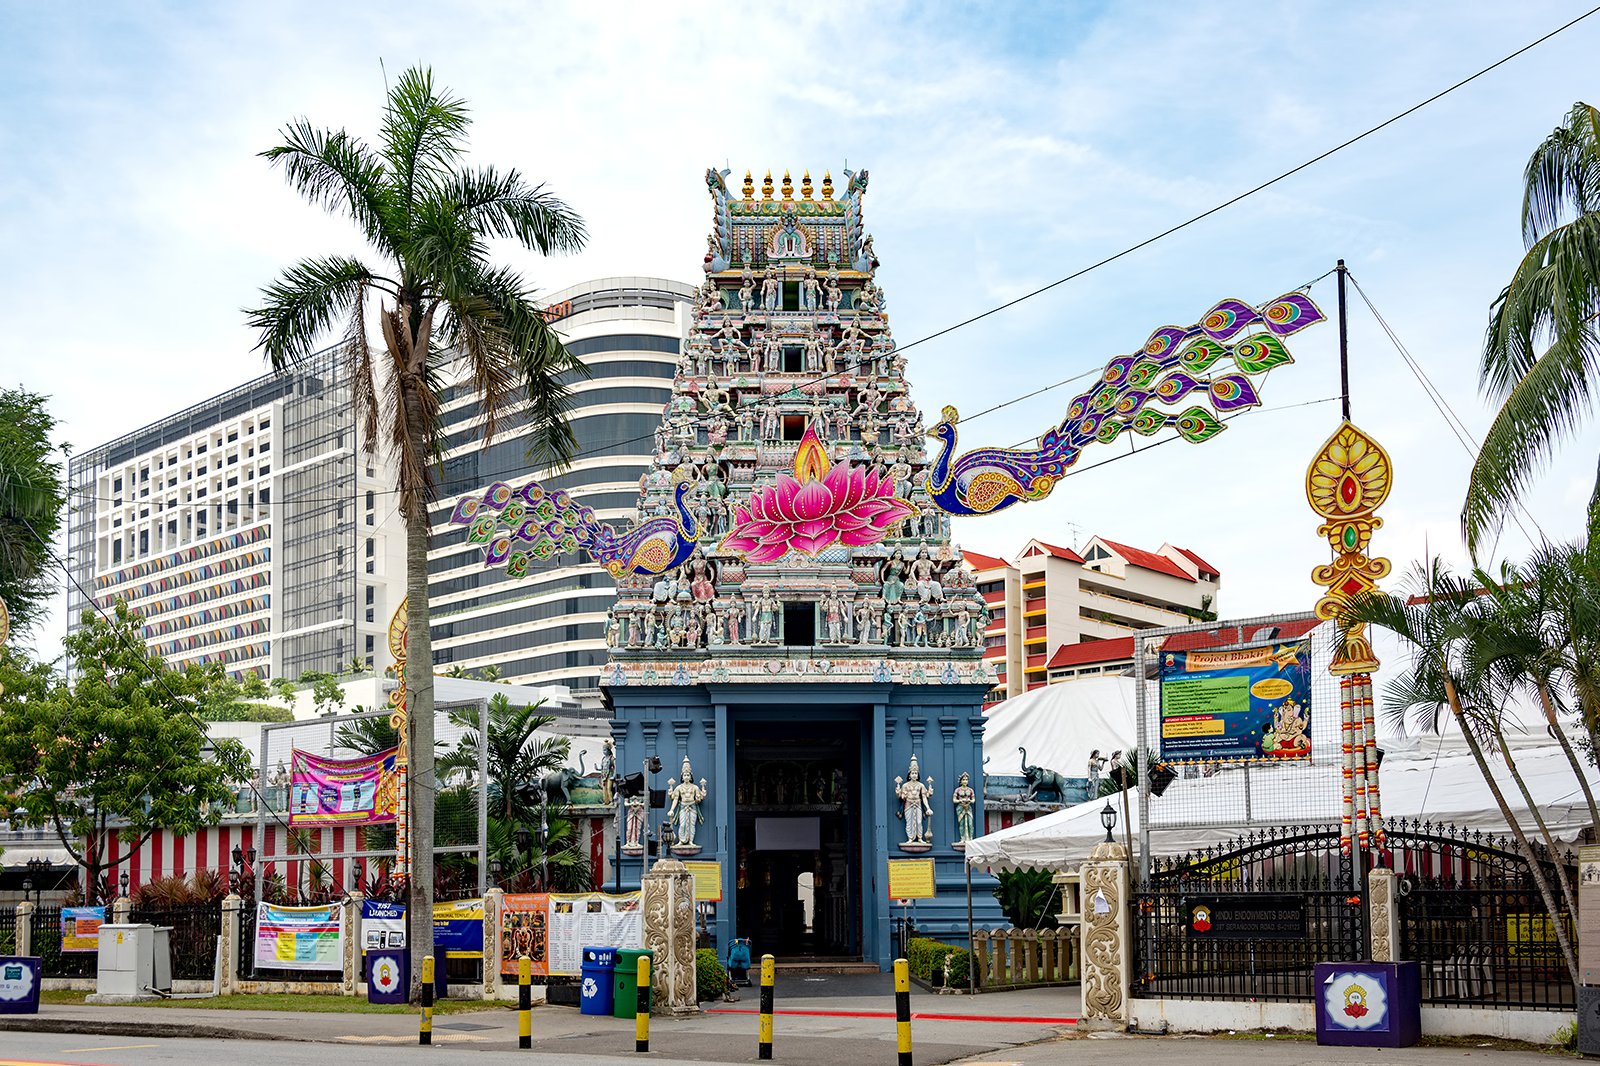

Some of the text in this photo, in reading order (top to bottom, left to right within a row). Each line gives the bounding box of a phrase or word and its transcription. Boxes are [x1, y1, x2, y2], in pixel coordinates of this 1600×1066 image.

[1193, 650, 1264, 662] Project Bhakti
[369, 909, 398, 917] LAUNCHED
[1216, 910, 1300, 920] HINDU ENDOWMENTS BOARD
